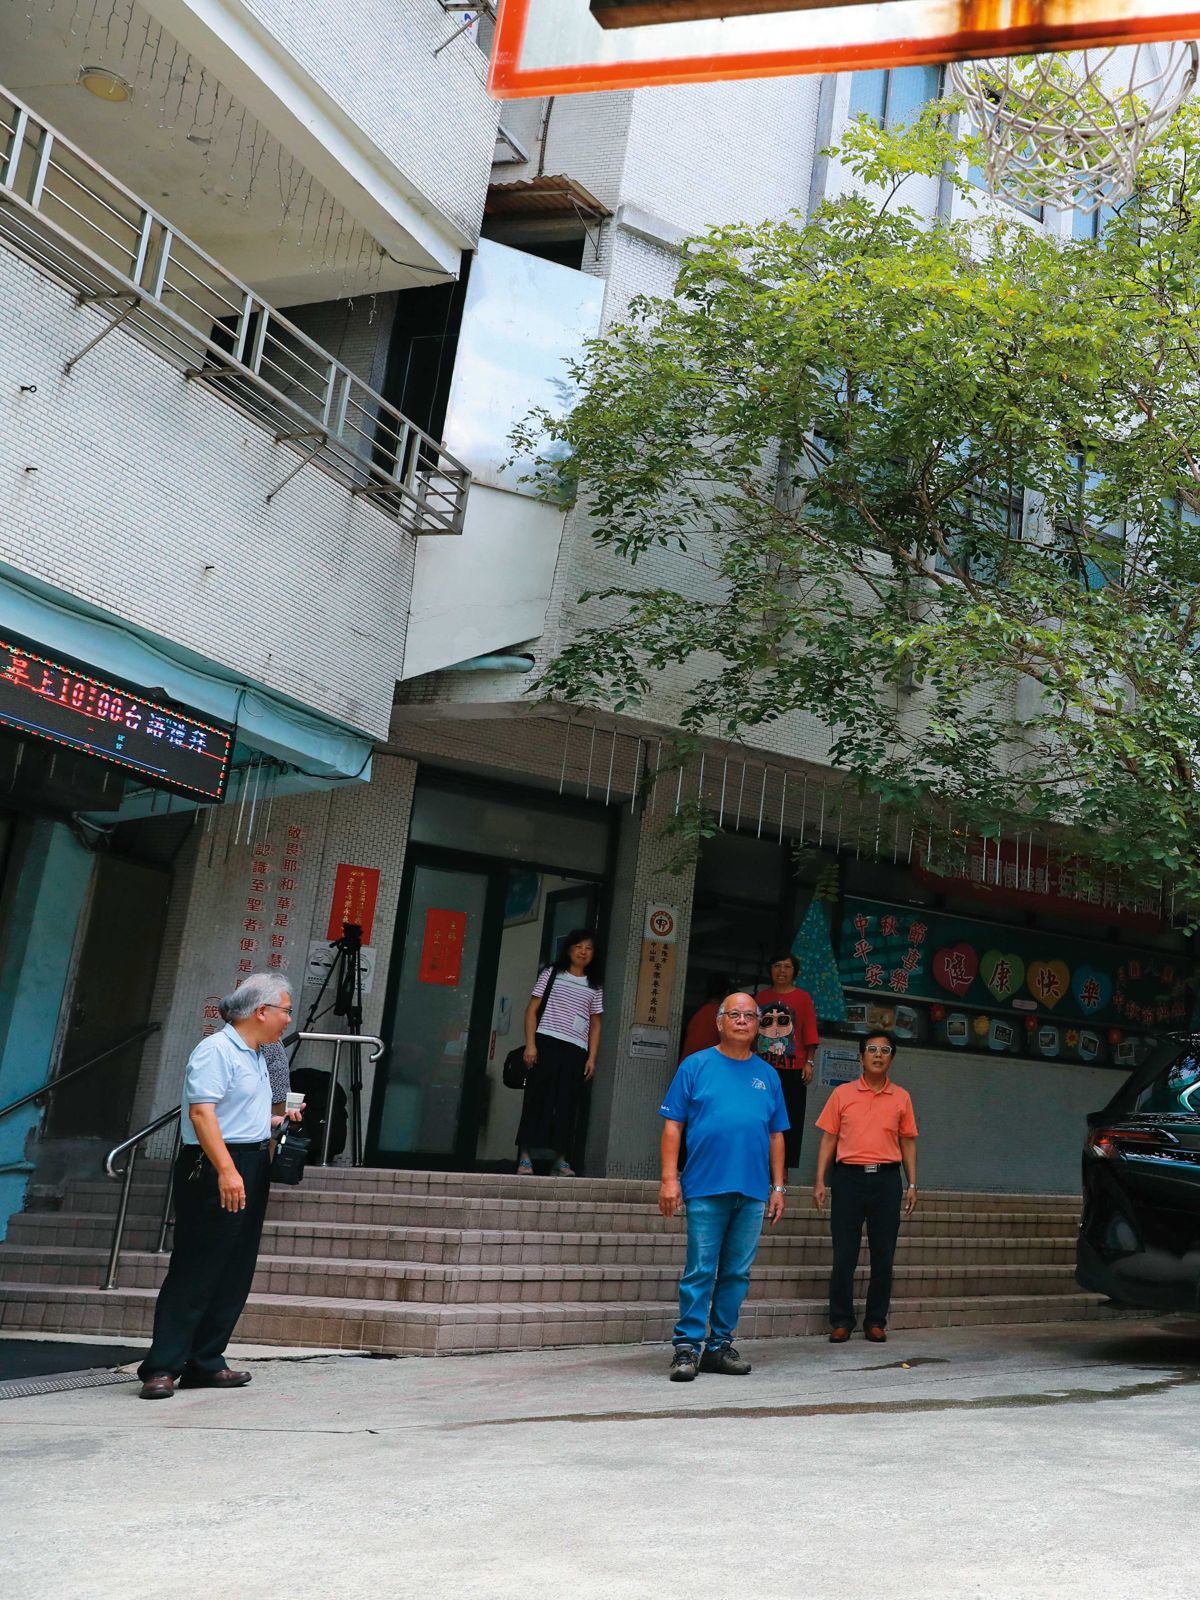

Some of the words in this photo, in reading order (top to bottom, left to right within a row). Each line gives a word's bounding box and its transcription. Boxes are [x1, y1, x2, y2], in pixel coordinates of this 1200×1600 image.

[235, 843, 271, 991] 認識至聖者便是
